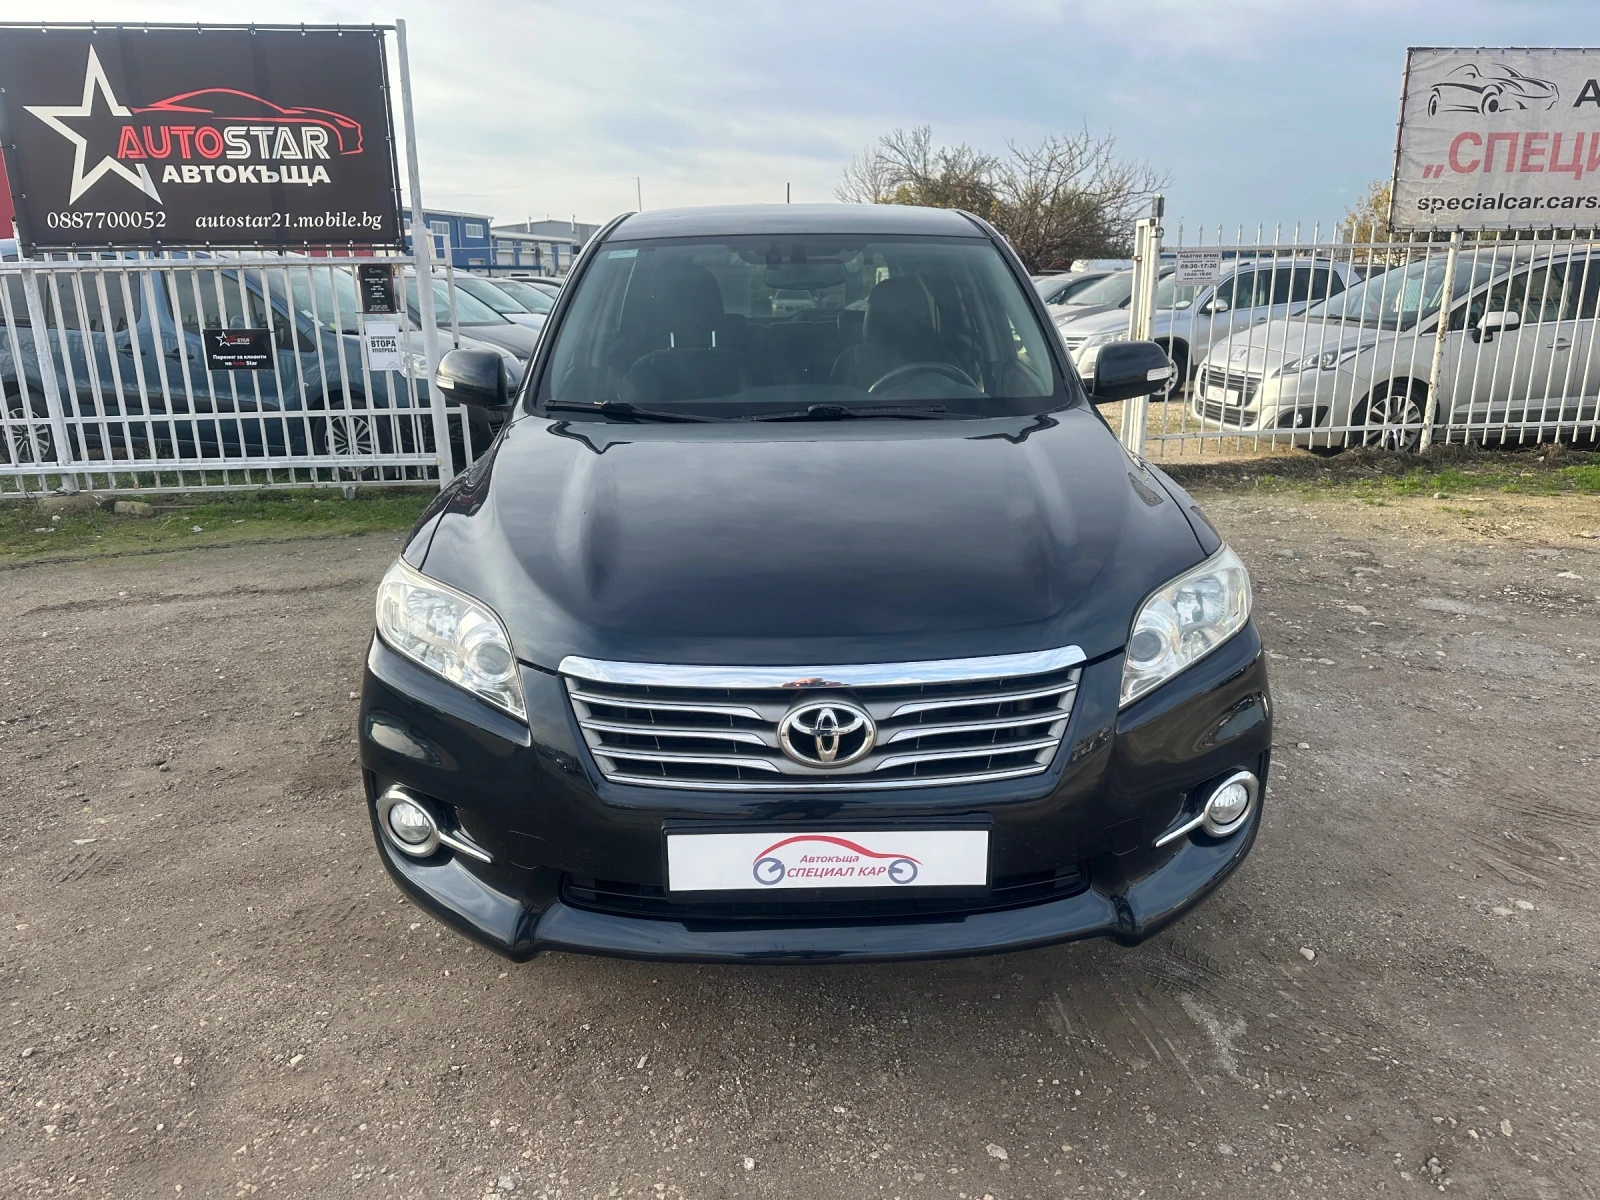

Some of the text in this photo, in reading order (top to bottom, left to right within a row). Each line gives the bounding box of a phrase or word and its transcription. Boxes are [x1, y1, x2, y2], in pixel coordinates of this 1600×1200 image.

[117, 126, 330, 159] AUTOSTAR
[162, 164, 331, 186] АВТОКЪЩА
[47, 210, 166, 229] 0887700052
[195, 210, 382, 231] autostar21.mobile.bg
[371, 340, 396, 348] ВТОРА
[799, 854, 860, 864] Автокъща
[787, 866, 886, 879] СПЕЦИАЛ КАР
